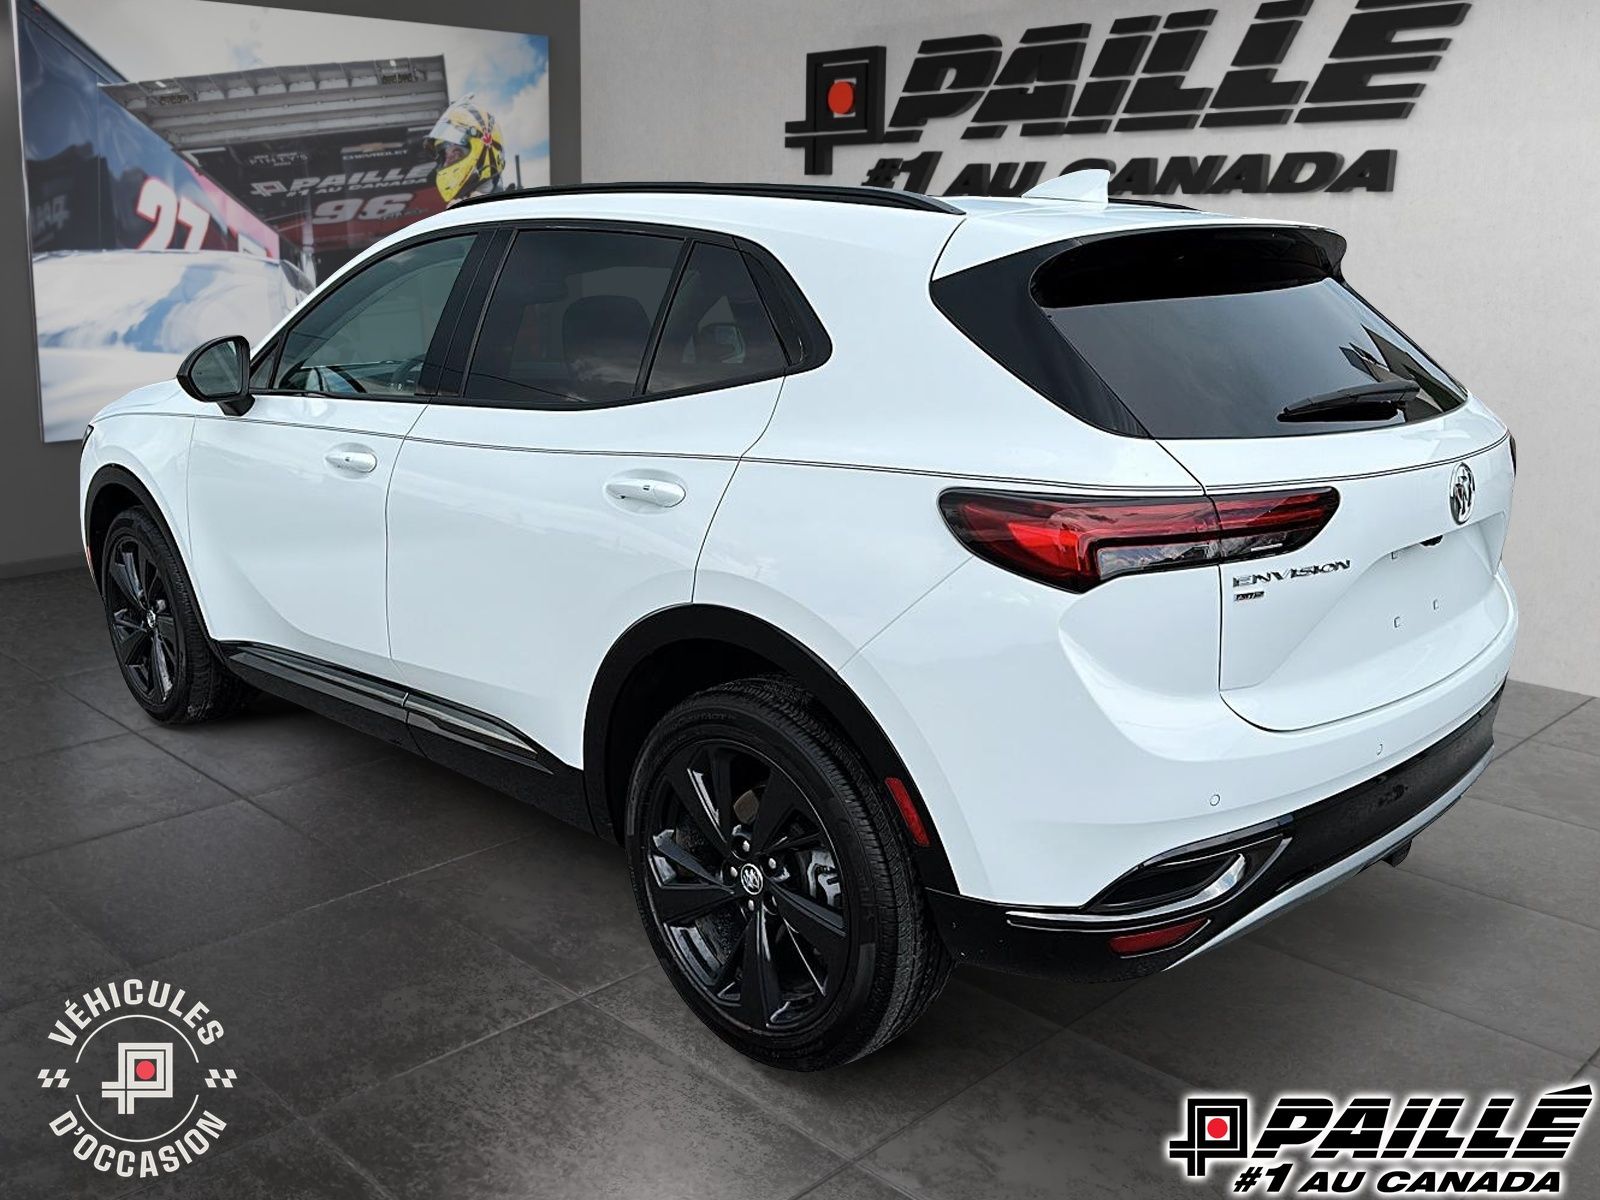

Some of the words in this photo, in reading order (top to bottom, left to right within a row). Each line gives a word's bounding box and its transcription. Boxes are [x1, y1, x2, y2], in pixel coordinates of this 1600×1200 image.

[315, 186, 343, 195] AU
[348, 177, 428, 191] CANADA
[860, 151, 943, 196] #1
[943, 161, 1047, 197] AU
[133, 177, 210, 251] 27
[311, 192, 414, 225] 96
[1232, 559, 1351, 588] ENVISION
